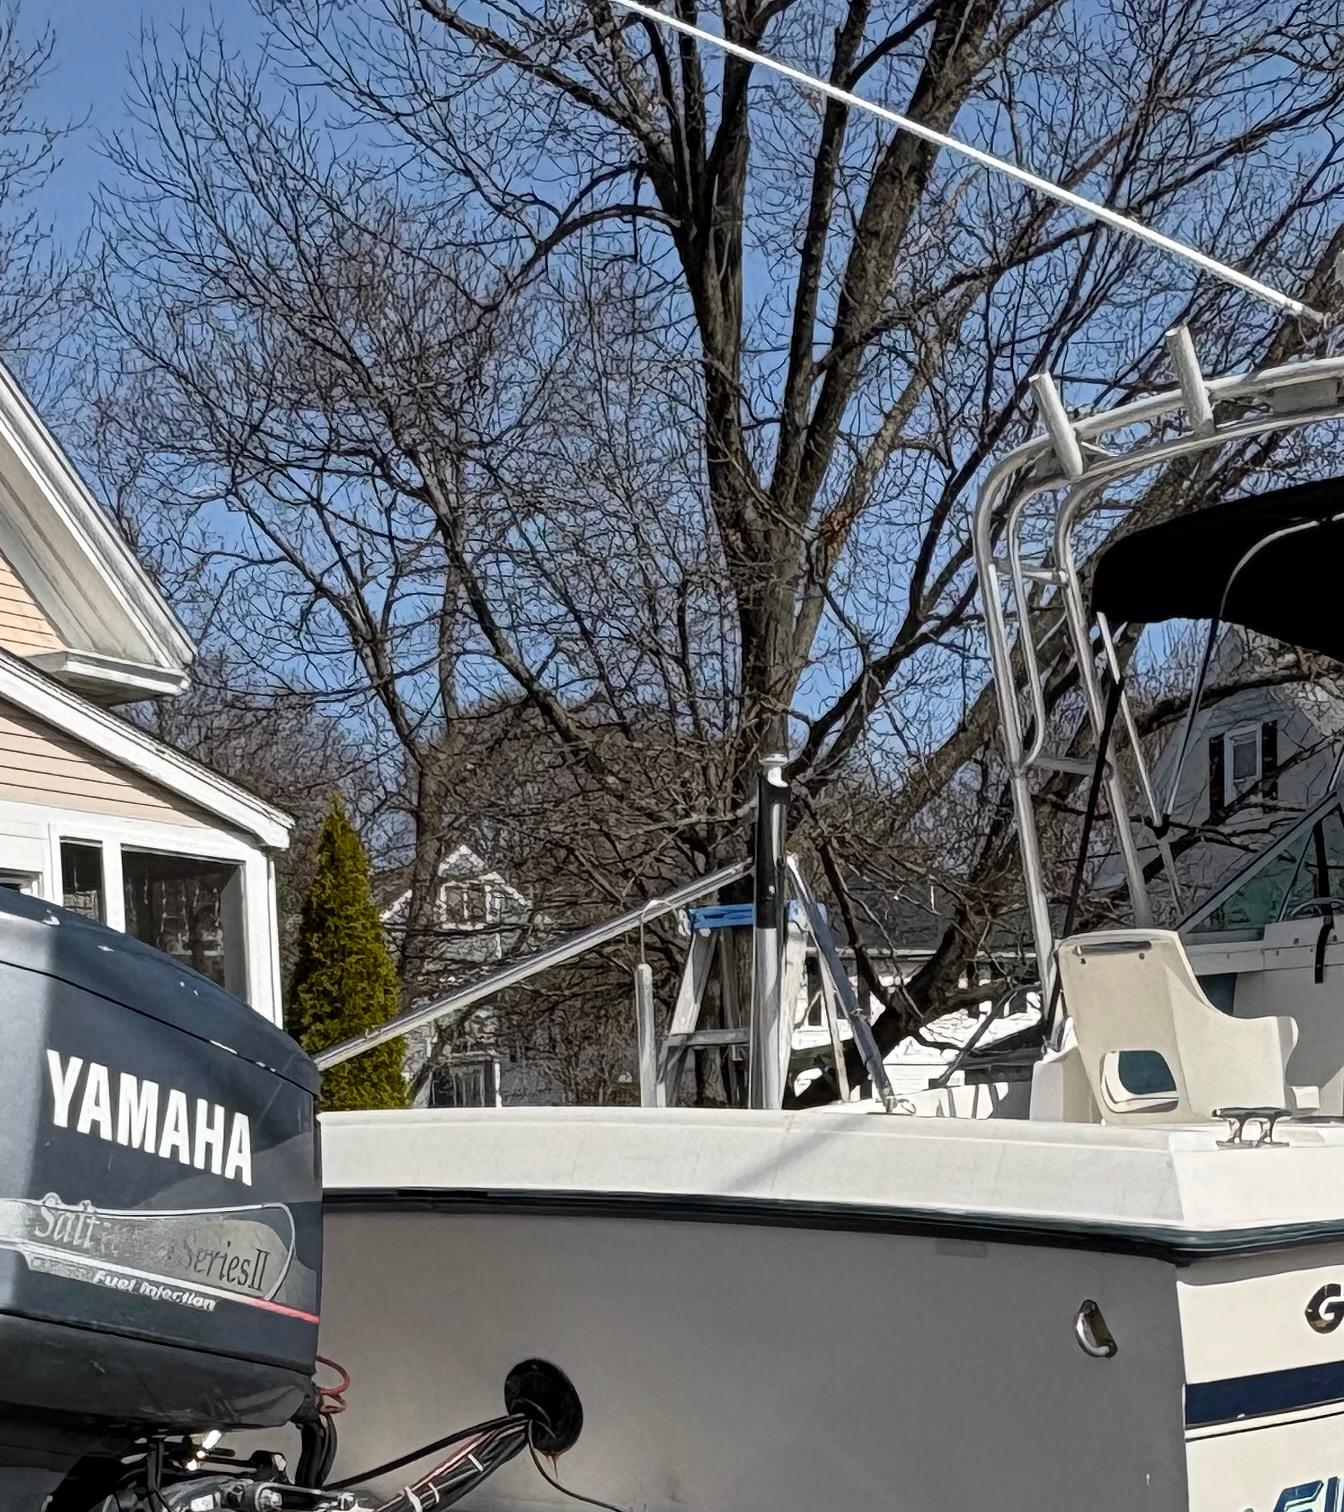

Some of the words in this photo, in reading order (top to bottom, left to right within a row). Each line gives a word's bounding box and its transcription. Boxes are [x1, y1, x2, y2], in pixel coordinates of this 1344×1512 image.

[47, 1049, 252, 1186] YAMAHA
[93, 1270, 136, 1291] Fuel
[140, 1281, 217, 1312] Injection
